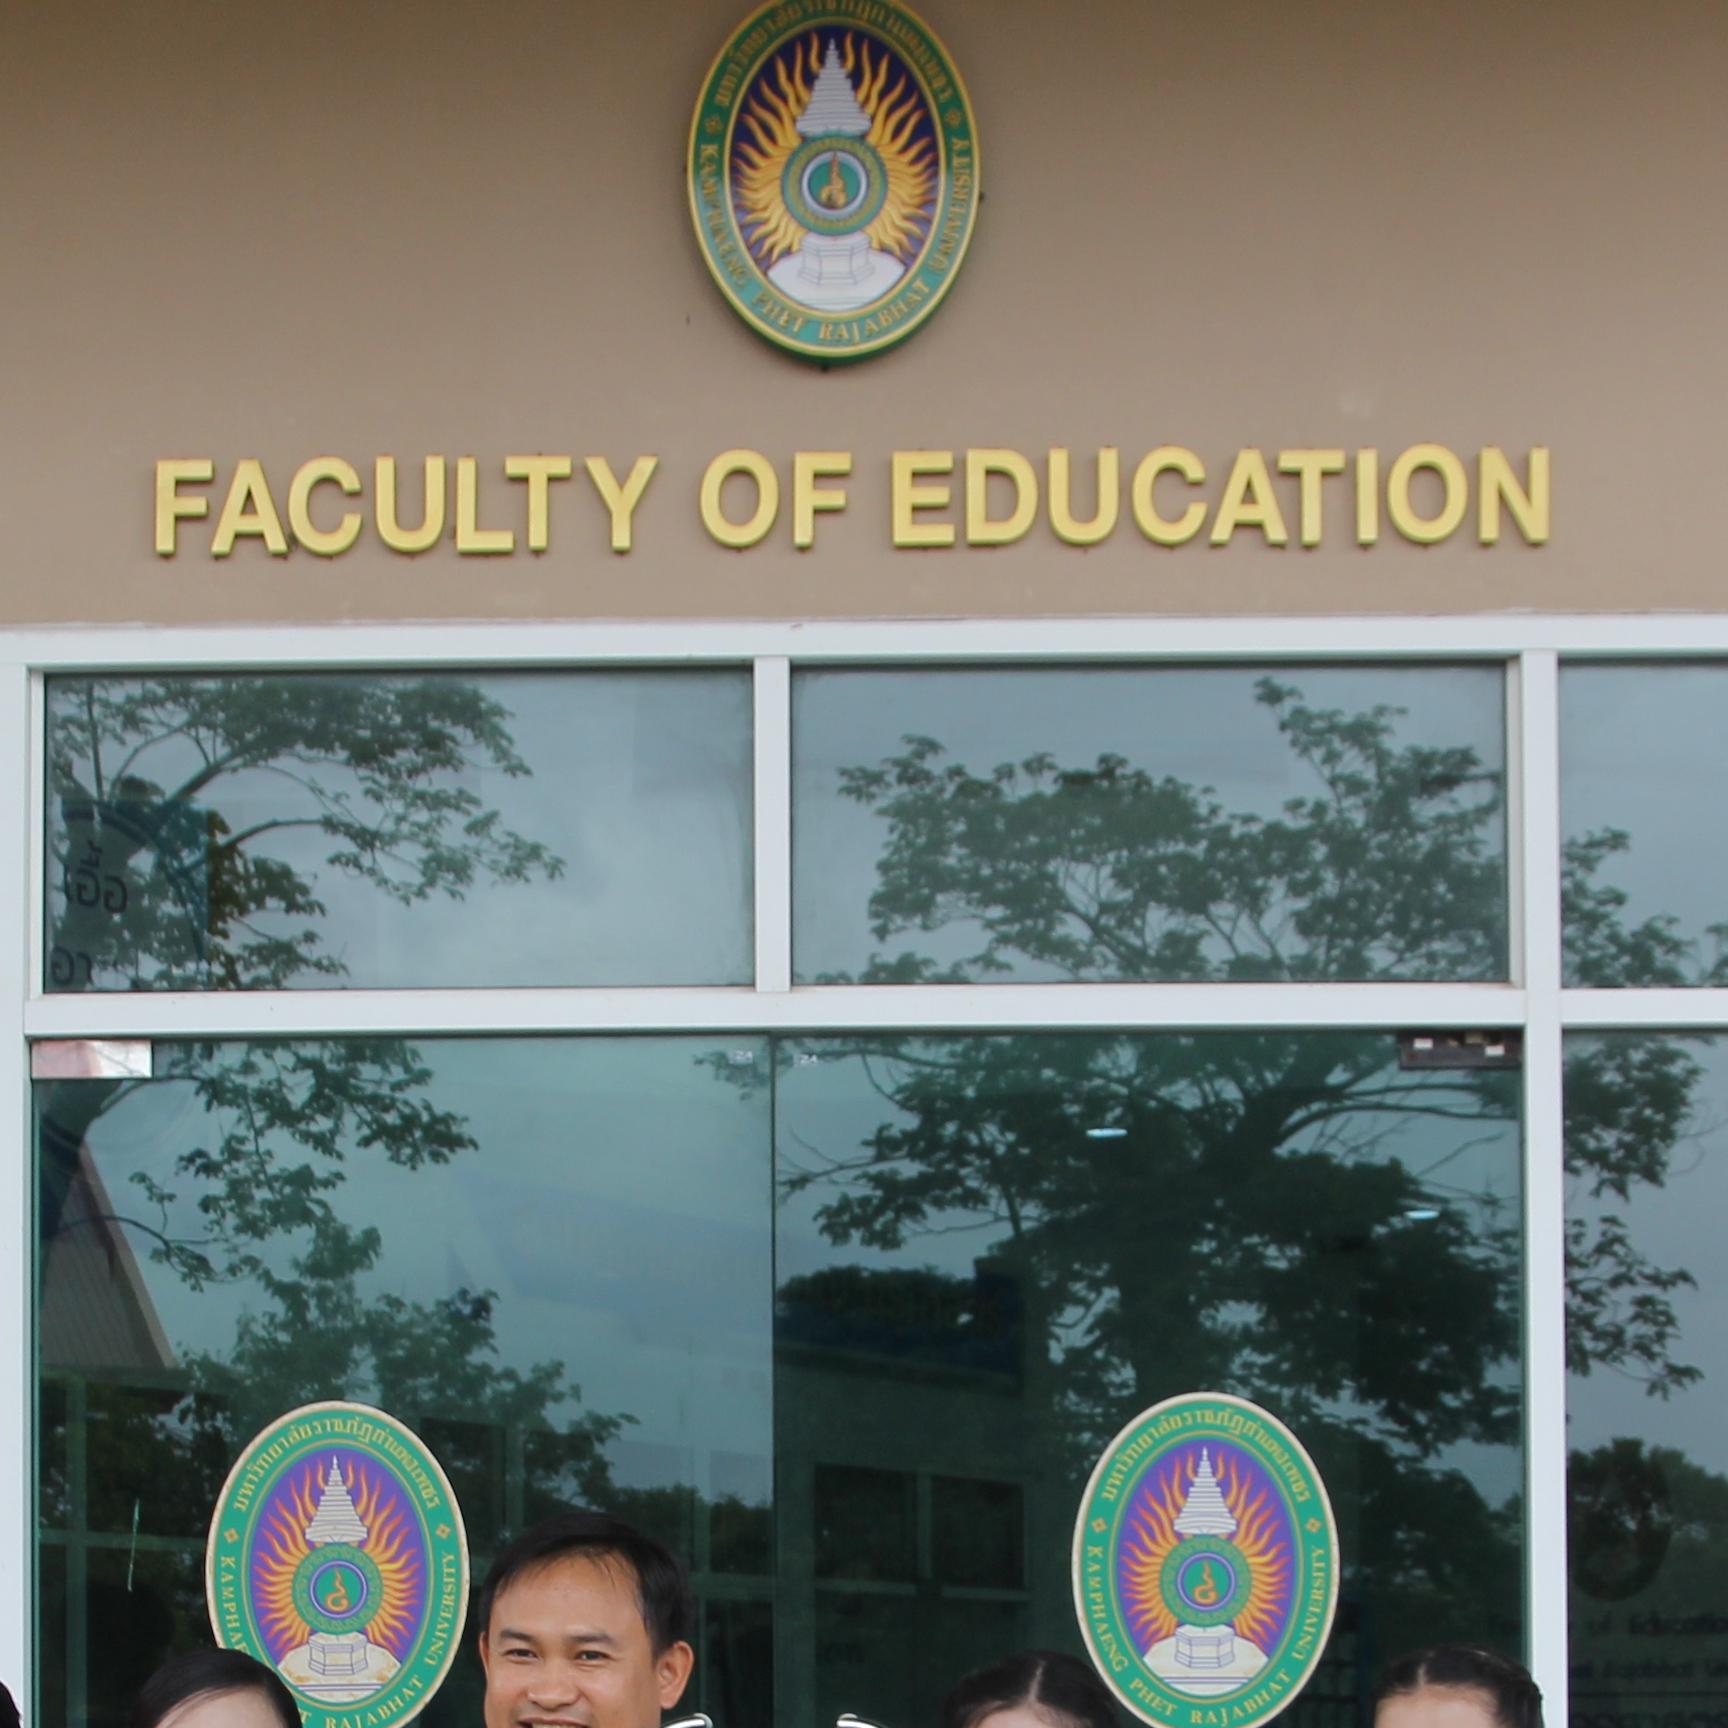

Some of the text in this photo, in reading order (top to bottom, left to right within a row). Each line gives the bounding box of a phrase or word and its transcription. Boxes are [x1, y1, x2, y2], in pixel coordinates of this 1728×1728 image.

[153, 443, 1552, 557] FACULTY OF EDUCATION
[220, 1556, 249, 1655] KAMPHAE
[425, 1551, 457, 1665] UNIVERSITY
[1087, 1545, 1327, 1727] KAMPHAENG PHET RAJABHAT UNIVERSITY
